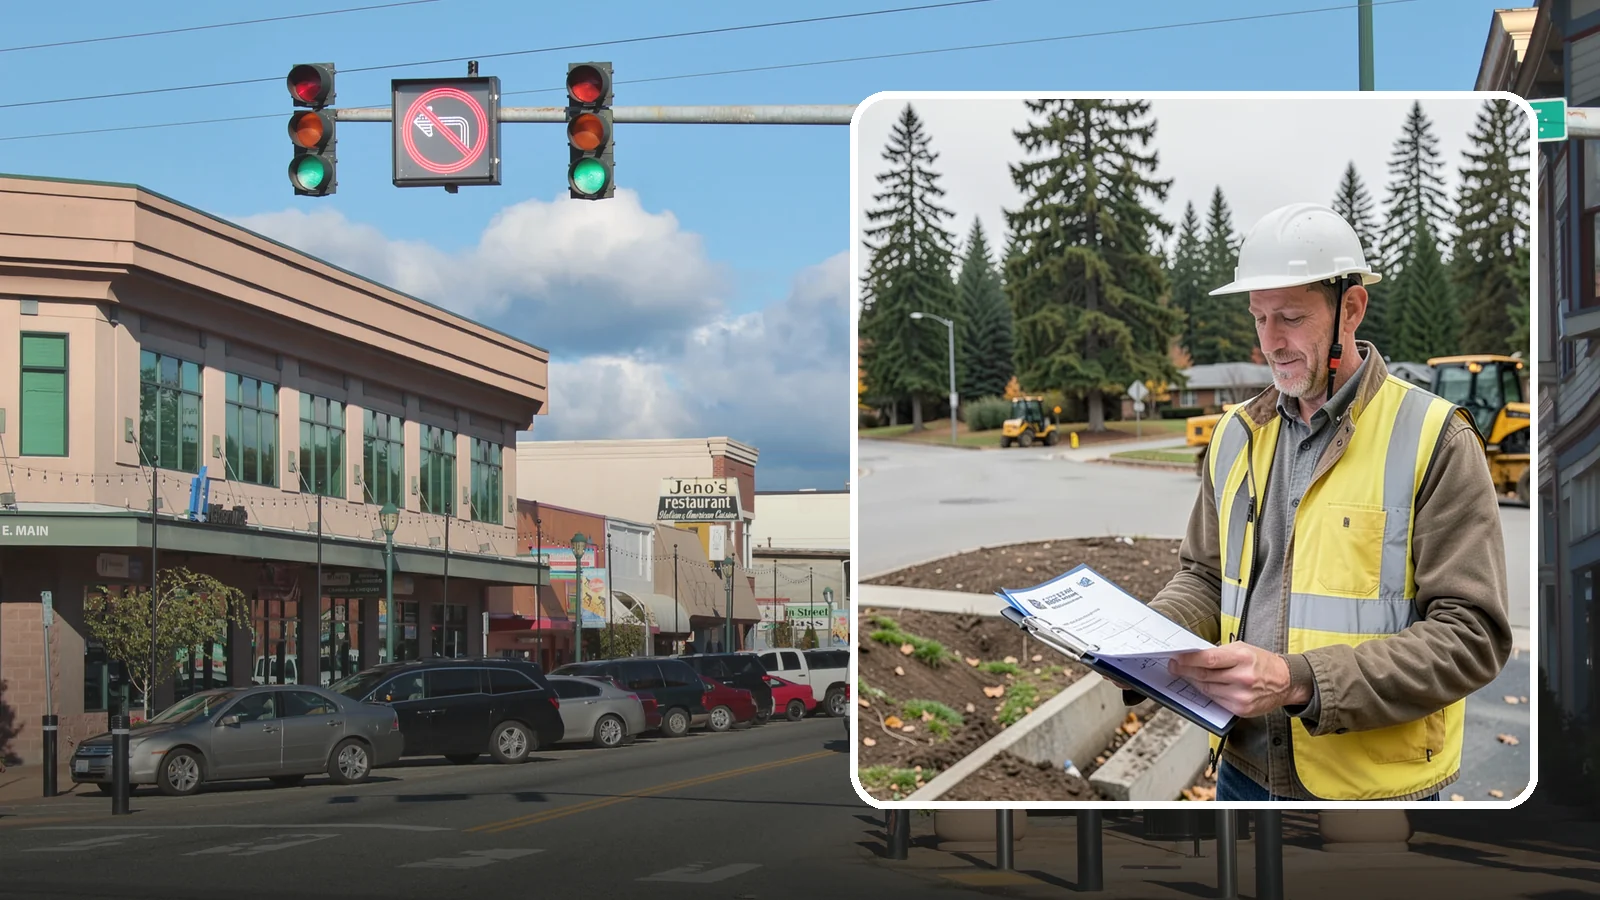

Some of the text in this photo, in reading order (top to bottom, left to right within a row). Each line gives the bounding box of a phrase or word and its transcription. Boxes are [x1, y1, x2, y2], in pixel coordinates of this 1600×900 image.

[670, 480, 727, 494] Jeno's
[665, 496, 731, 509] restaurant
[686, 510, 714, 519] American
[715, 510, 737, 519] Cuisine
[2, 525, 49, 536] E. MAIN
[797, 607, 828, 617] Street
